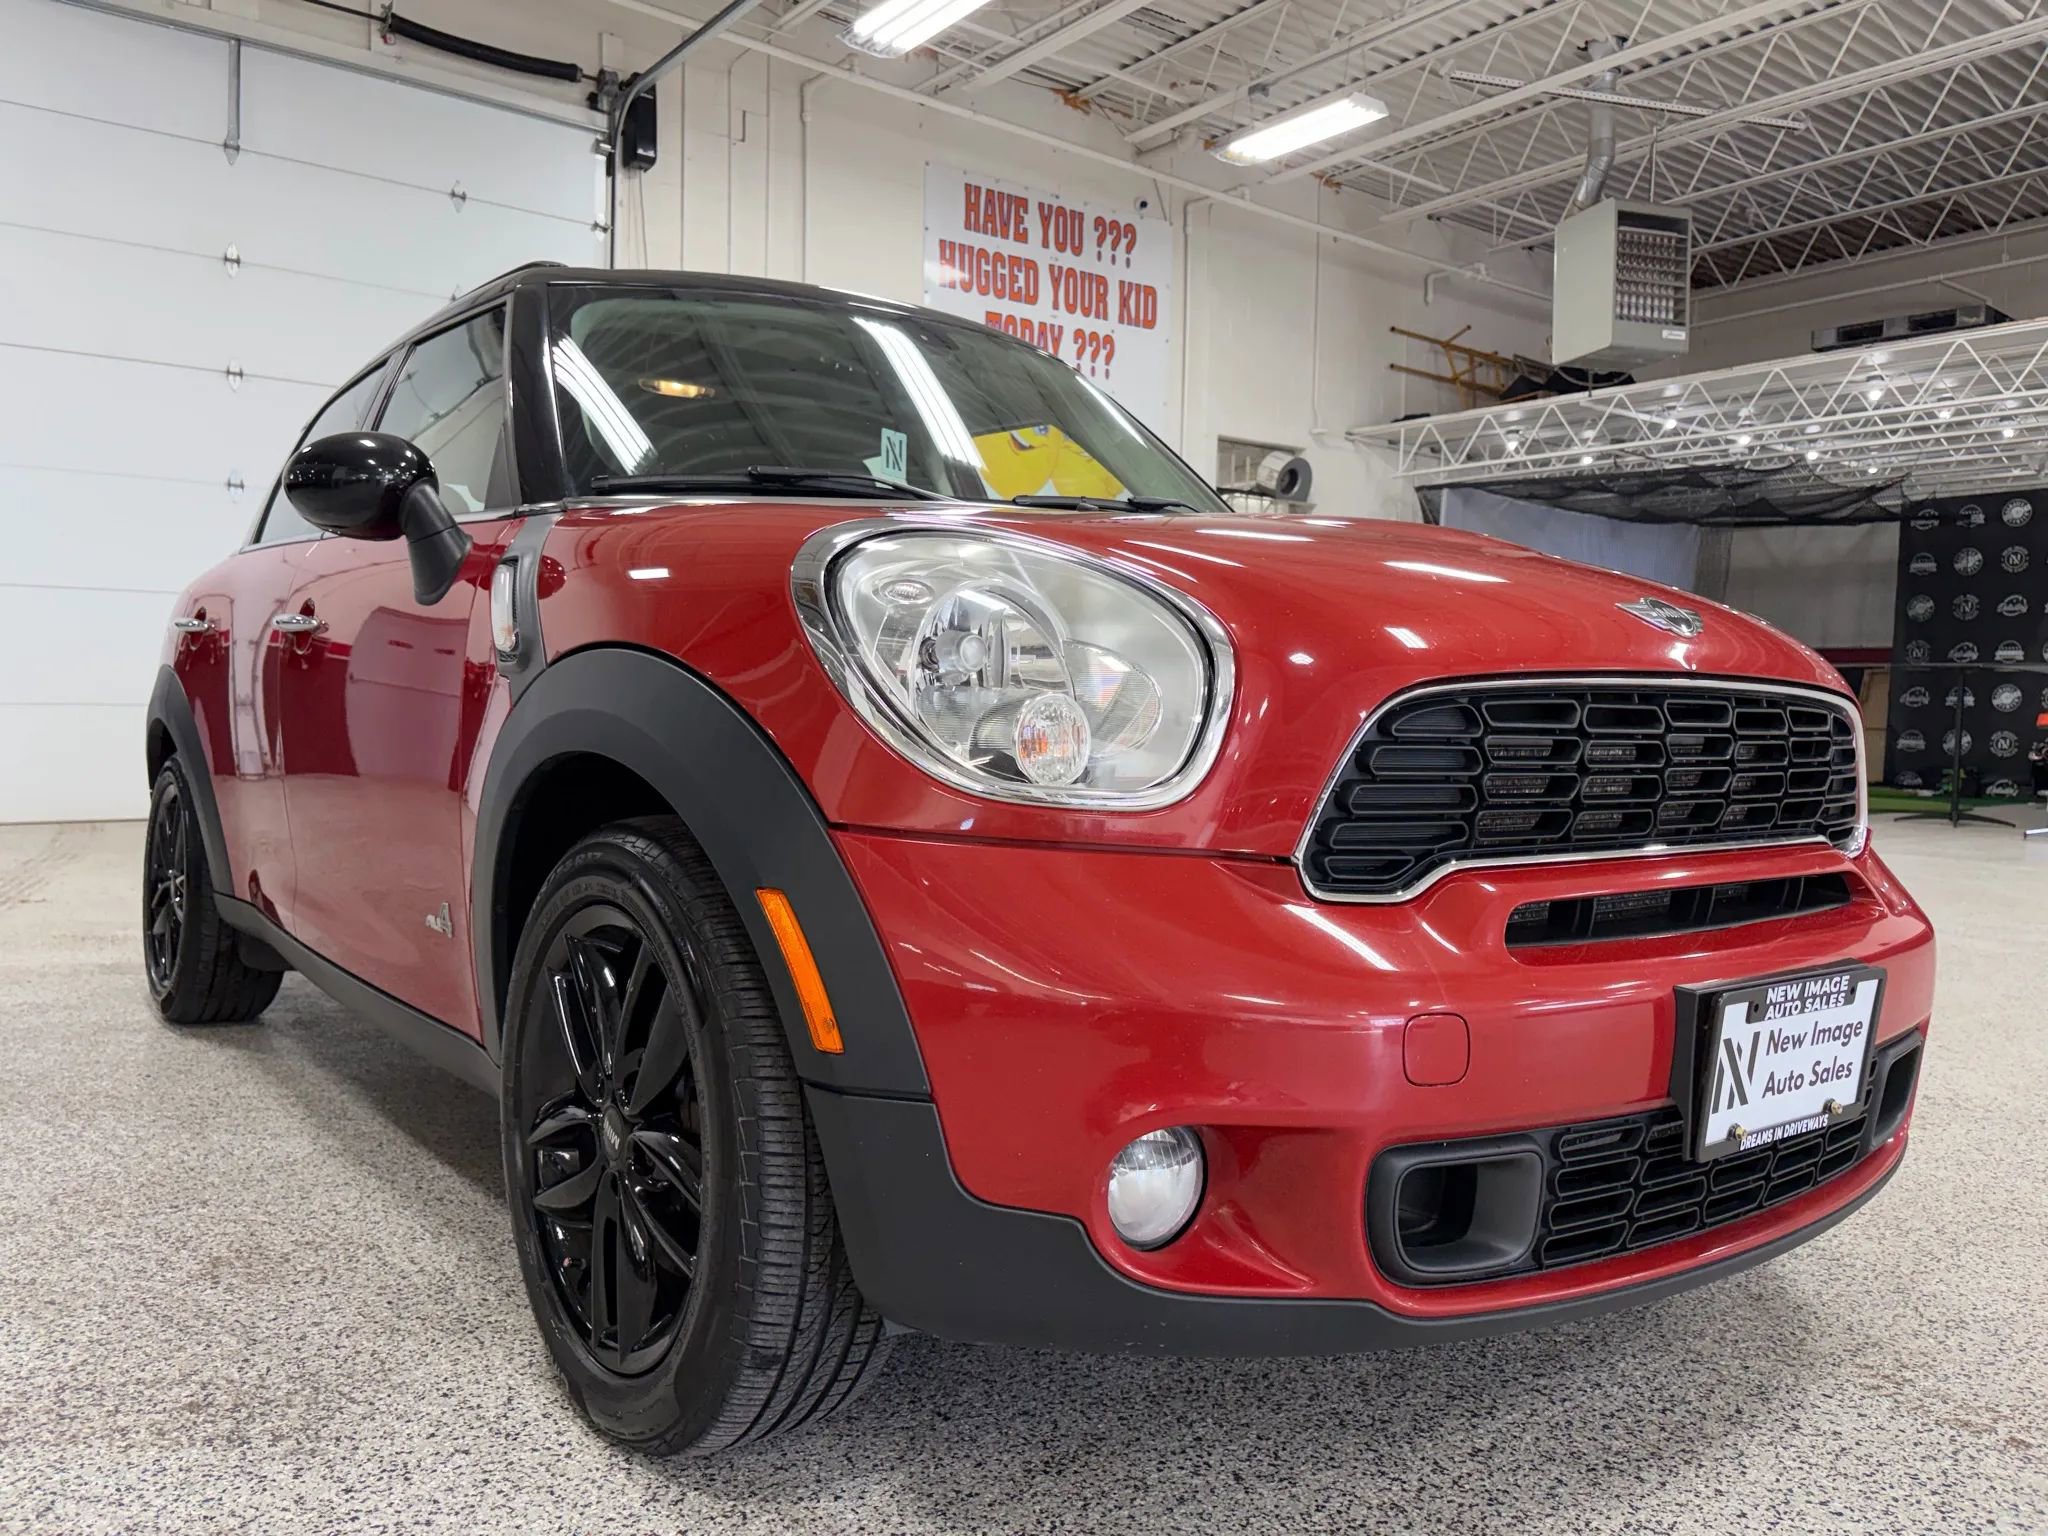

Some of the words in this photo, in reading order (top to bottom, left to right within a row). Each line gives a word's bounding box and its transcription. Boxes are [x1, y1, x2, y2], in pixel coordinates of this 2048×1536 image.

[963, 182, 1029, 244] HAVE
[1038, 201, 1085, 257] YOU
[1094, 216, 1138, 269] ???
[938, 239, 1040, 306] HUGGED
[1048, 263, 1109, 321] YOUR
[1117, 280, 1158, 330] KID
[1073, 328, 1116, 379] ???
[1764, 1000, 1801, 1021] AUTO
[1804, 992, 1846, 1013] SALES
[1766, 983, 1802, 1004] NEW
[1804, 975, 1850, 998] IMAGE
[1766, 1027, 1808, 1056] New
[1810, 1020, 1864, 1047] Image
[1761, 1071, 1805, 1099] Auto
[1808, 1056, 1854, 1087] Sales
[1740, 1129, 1774, 1150] DREAMS
[1773, 1125, 1784, 1141] IN
[1783, 1114, 1829, 1138] DRIVEWAYS
